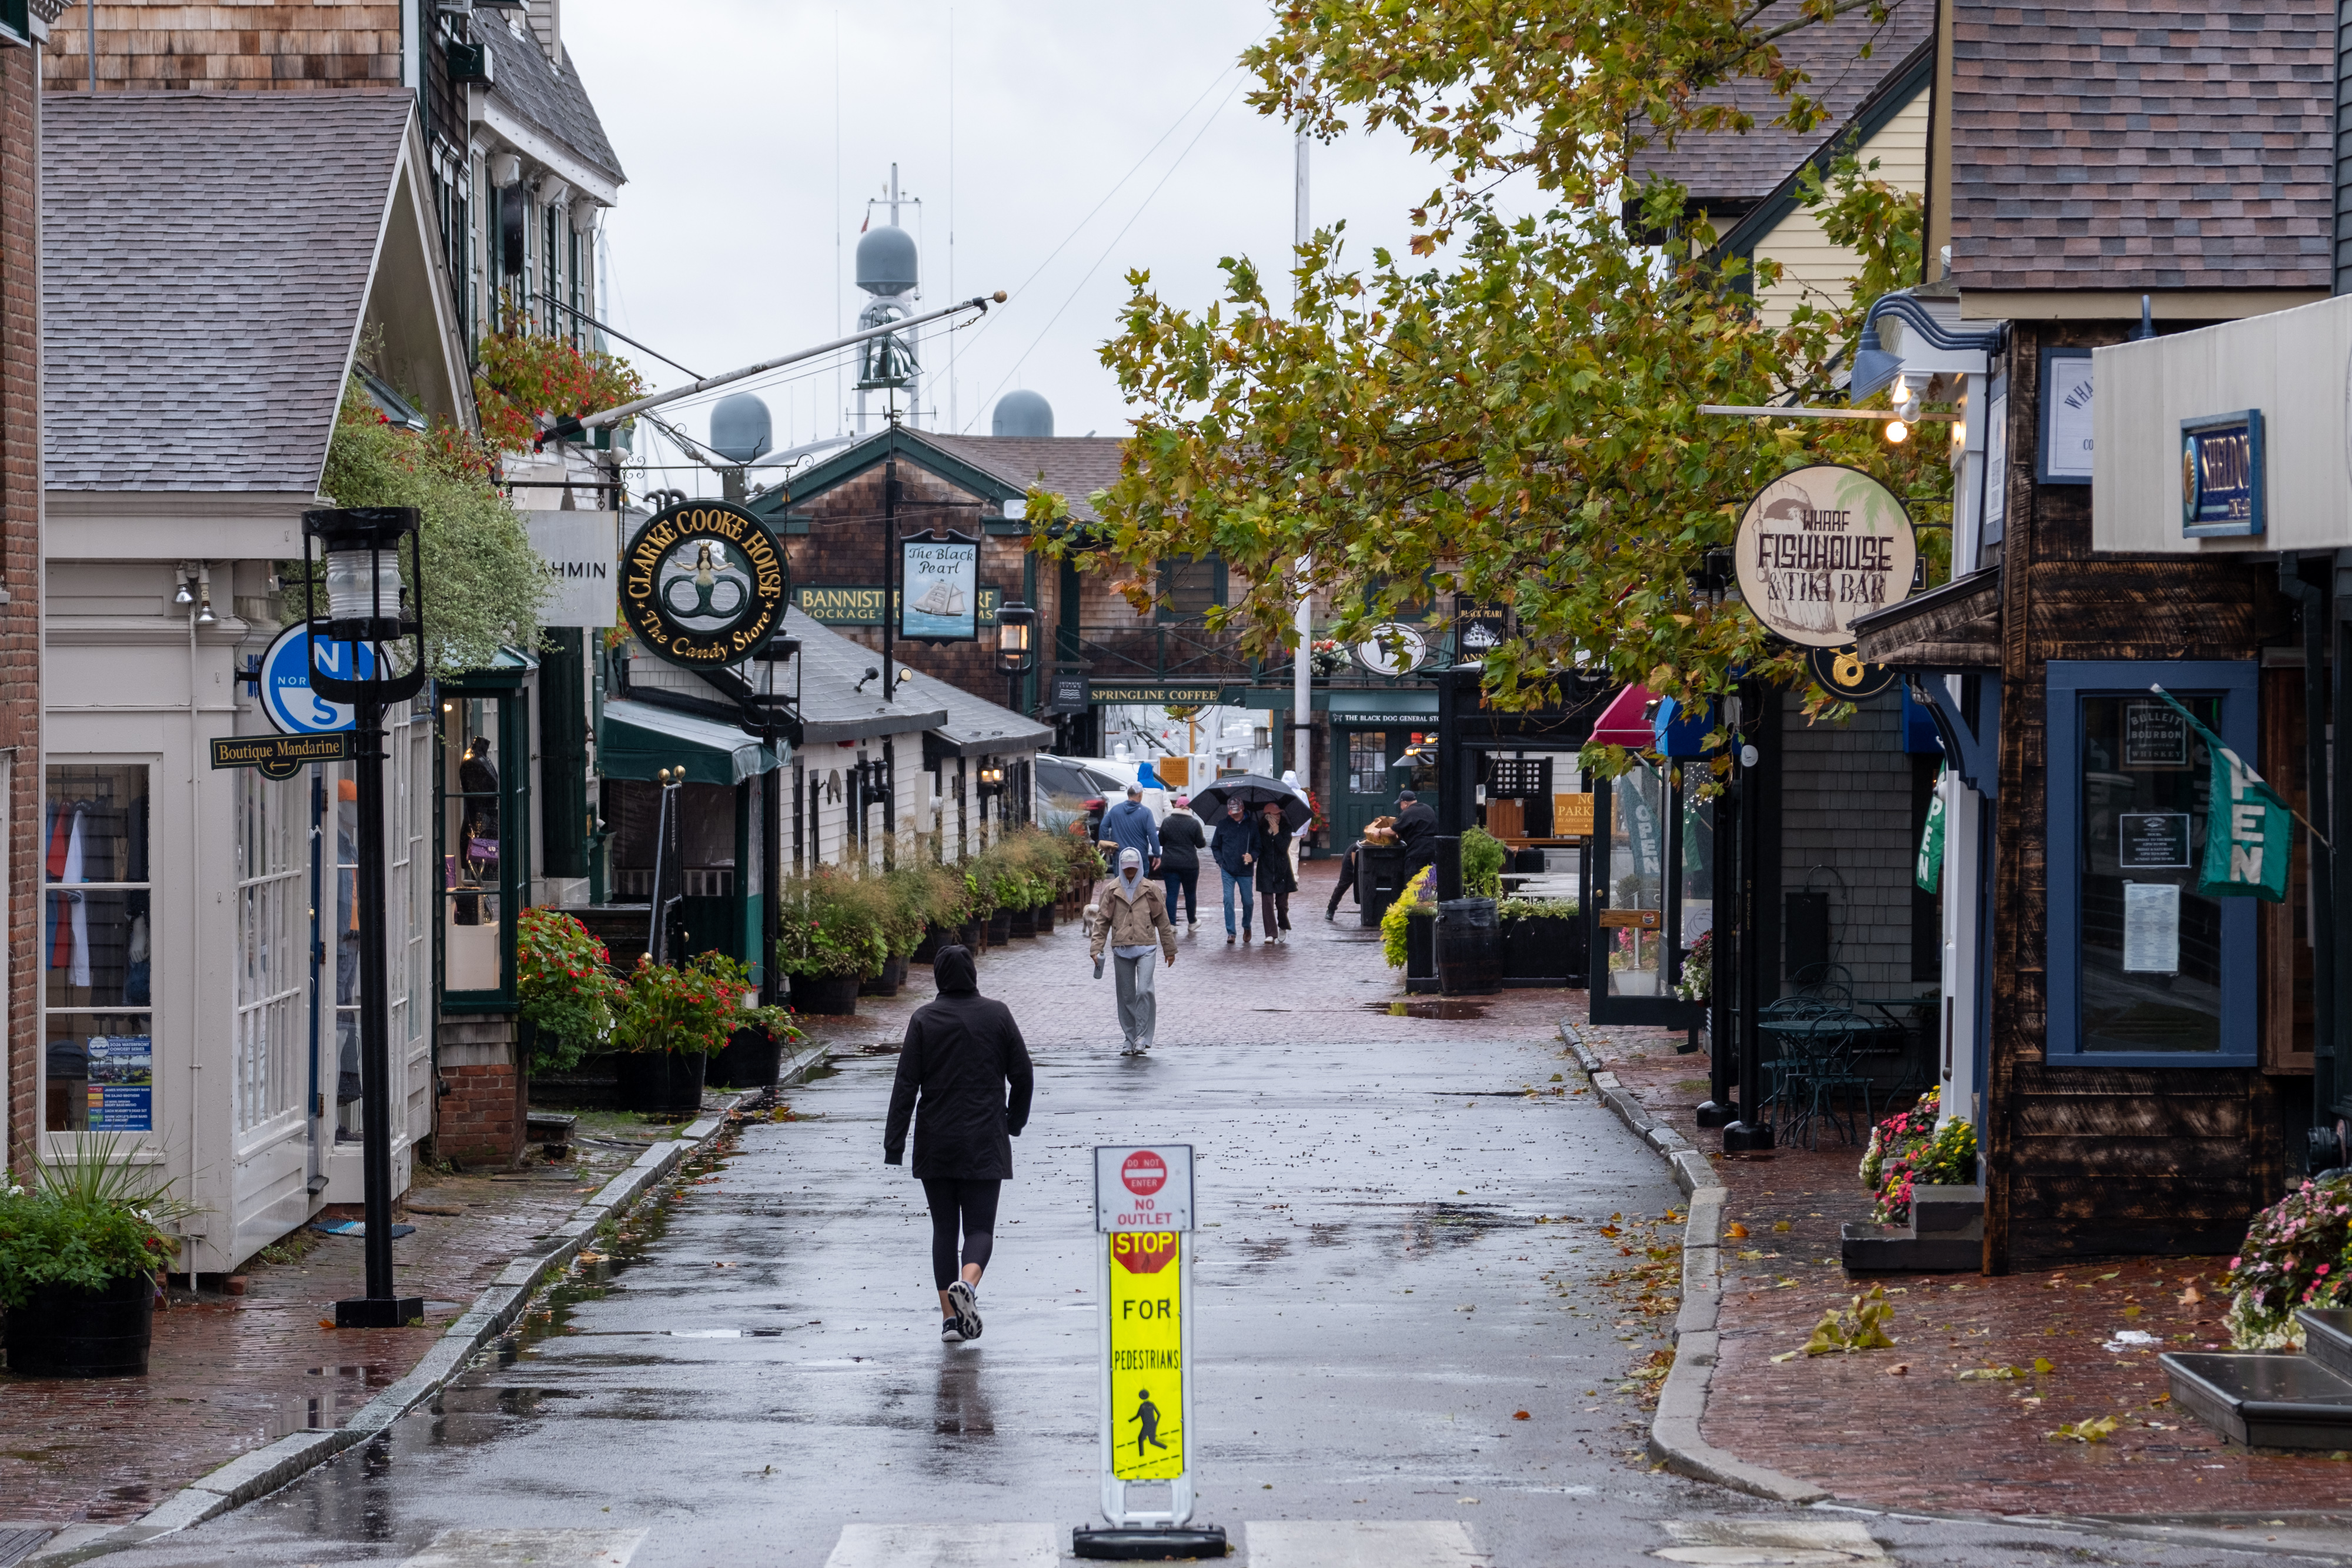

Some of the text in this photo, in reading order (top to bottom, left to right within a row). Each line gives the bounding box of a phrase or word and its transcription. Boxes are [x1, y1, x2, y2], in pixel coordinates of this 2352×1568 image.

[1803, 509, 1850, 531] WHARF
[629, 509, 781, 599] CLARKE COOKE HOUSE
[909, 546, 973, 561] The Black
[1758, 533, 1894, 571] FISHHOUSE
[918, 561, 961, 574] Pearl
[1768, 572, 1885, 603] & TIKI BAR
[641, 610, 771, 661] The Candy Store
[1461, 653, 1486, 662] ANN
[278, 676, 306, 685] NOR
[1092, 690, 1217, 700] SPRINGLINE COFFEE
[312, 694, 338, 726] S
[2130, 712, 2183, 726] BULLEIT
[219, 740, 340, 761] Boutique Mandarine
[1635, 805, 1661, 874] OPEN
[1747, 880, 1751, 888] NO
[1131, 1179, 1158, 1187] ENTER
[1135, 1199, 1155, 1211] NO
[1118, 1213, 1172, 1225] OUTLET
[1117, 1232, 1174, 1254] STOP
[1124, 1298, 1171, 1319] FOR
[1115, 1349, 1179, 1370] PEDESTRIANS
